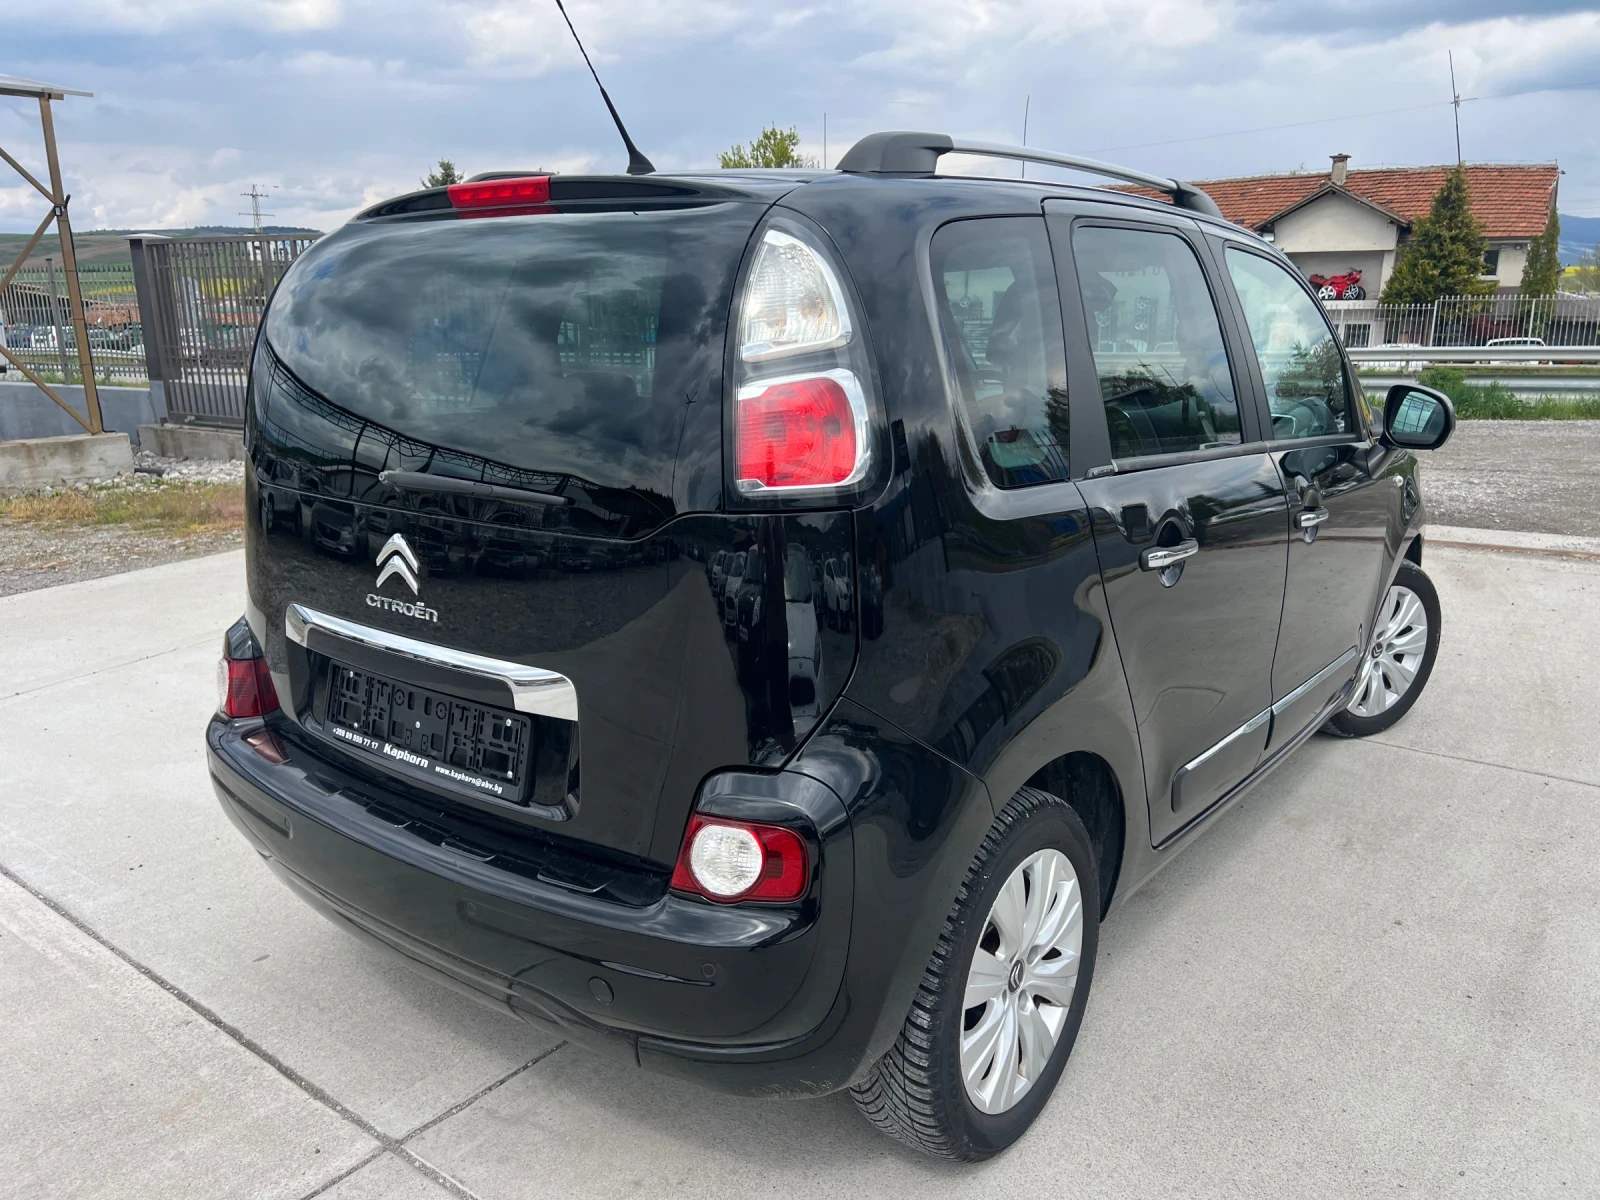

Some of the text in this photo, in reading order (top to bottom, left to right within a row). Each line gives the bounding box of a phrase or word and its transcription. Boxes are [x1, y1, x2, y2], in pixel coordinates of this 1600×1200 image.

[363, 738, 371, 747] 77
[371, 741, 379, 750] 17
[383, 743, 429, 768] Kaphorn
[435, 765, 503, 794] www.kaphorn@abv.bg
